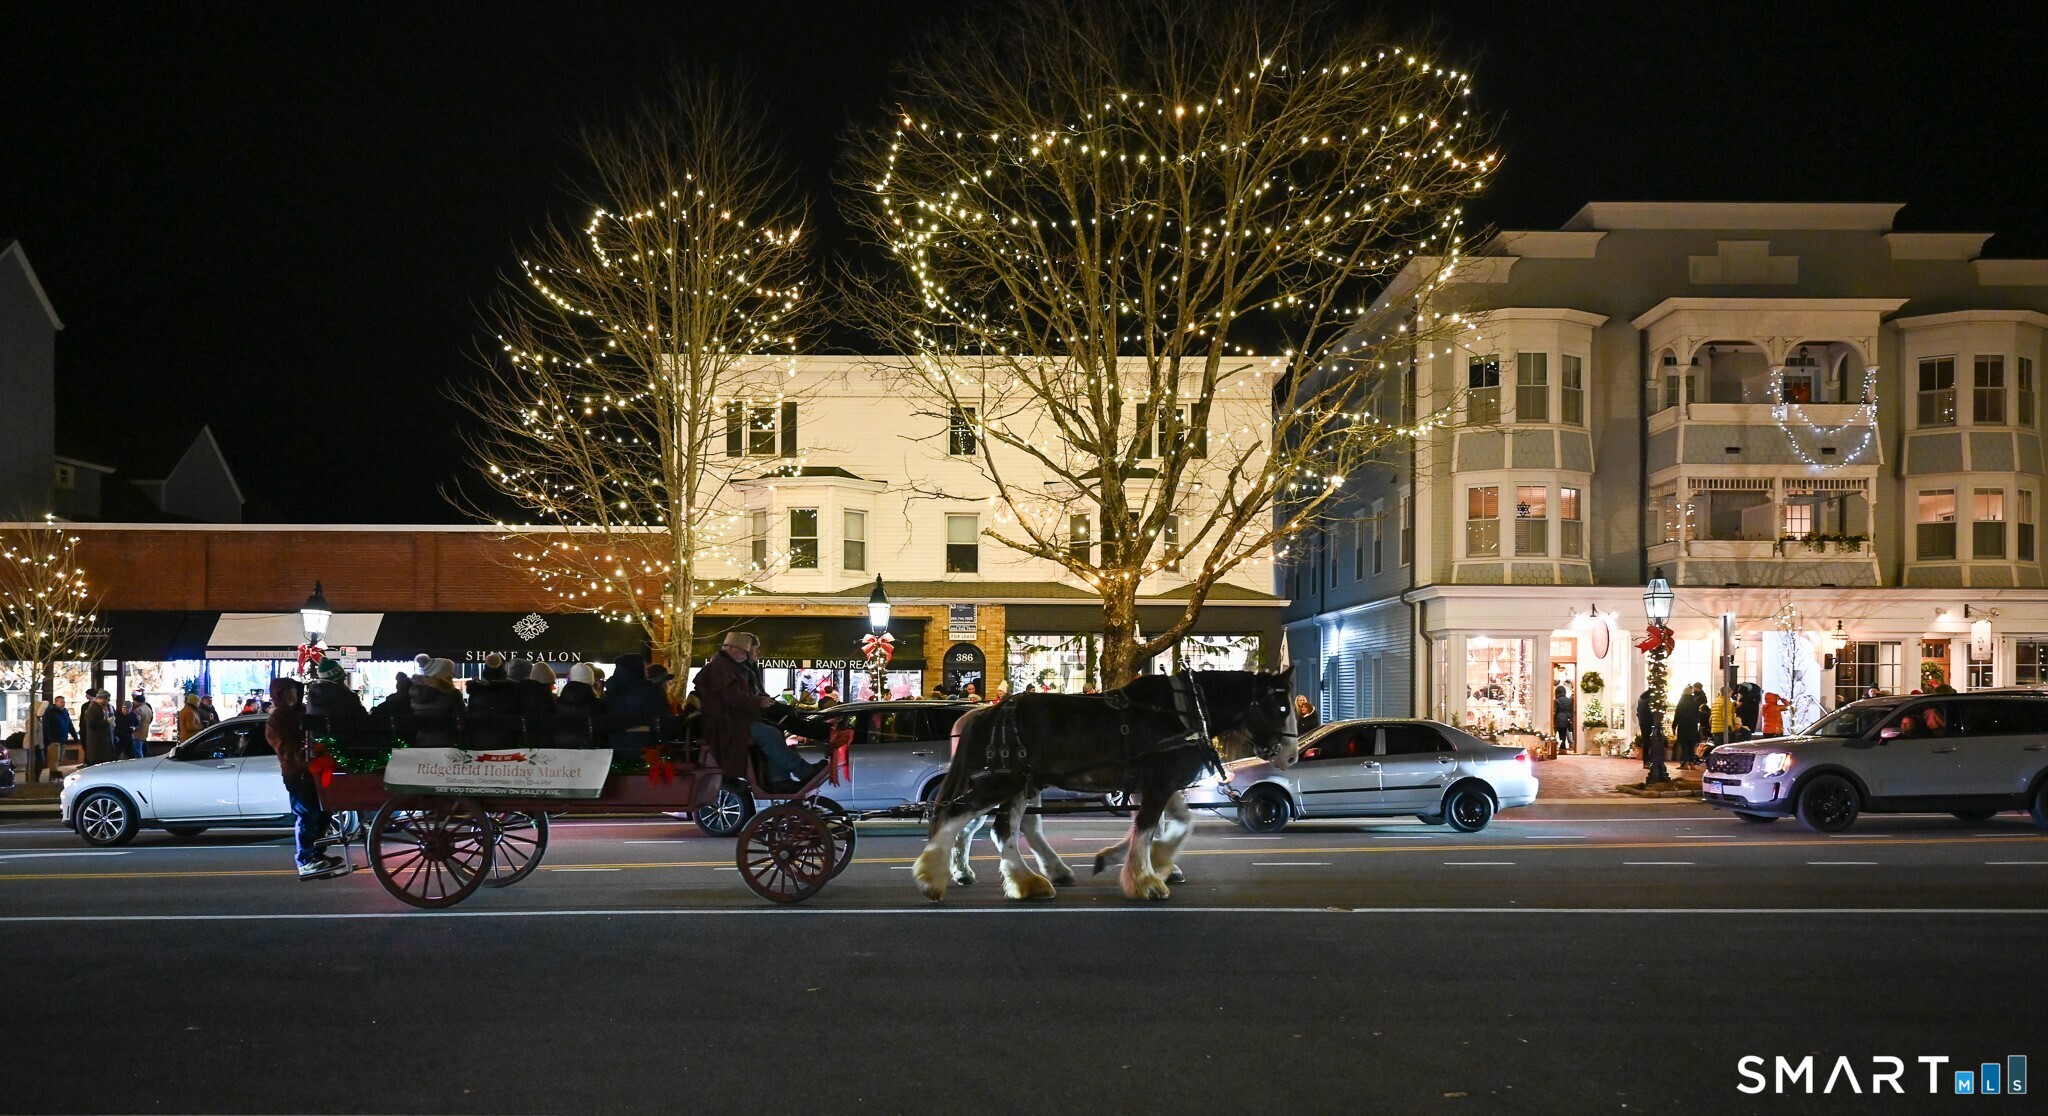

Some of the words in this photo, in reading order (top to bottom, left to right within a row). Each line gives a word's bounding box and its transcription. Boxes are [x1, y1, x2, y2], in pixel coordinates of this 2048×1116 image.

[465, 651, 518, 661] SHNE
[526, 651, 581, 662] SALON
[955, 653, 974, 662] 386
[757, 657, 797, 669] HANNA
[815, 659, 847, 669] RAND
[416, 763, 480, 777] Ridgefield
[484, 764, 534, 779] Holiday
[537, 765, 582, 778] Market
